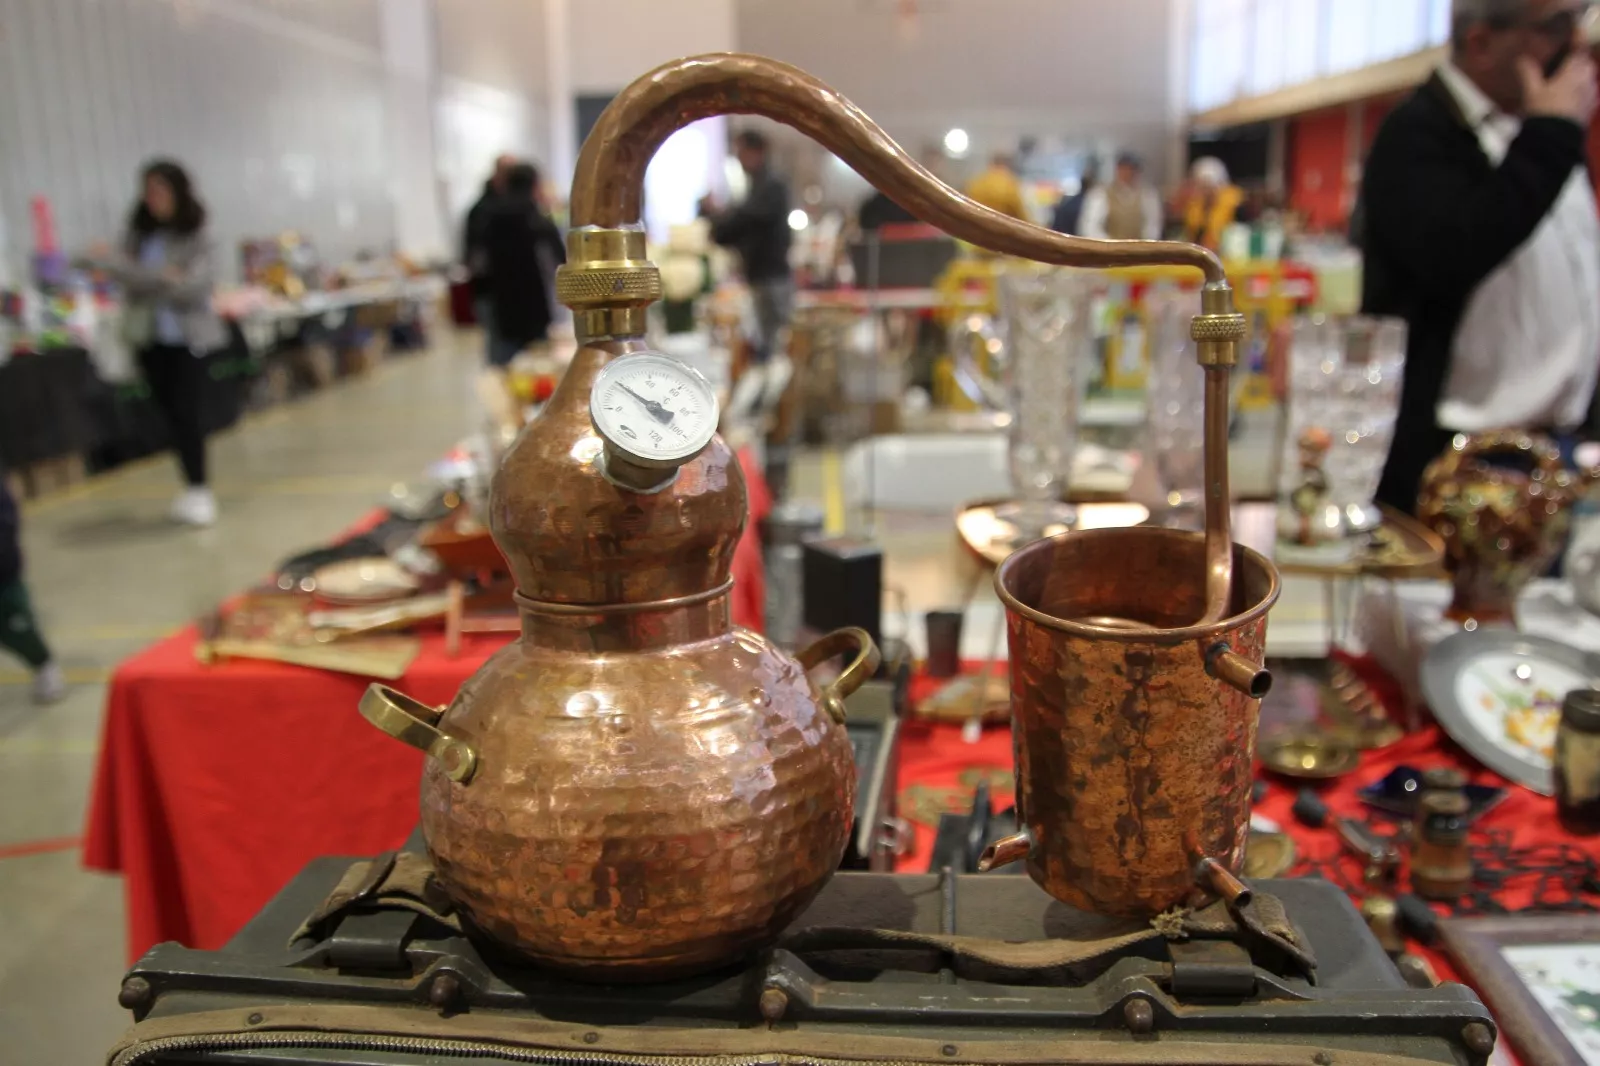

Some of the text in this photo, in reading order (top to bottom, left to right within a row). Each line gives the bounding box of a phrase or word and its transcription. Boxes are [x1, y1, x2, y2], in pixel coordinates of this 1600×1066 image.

[645, 380, 656, 389] 40
[669, 388, 680, 397] 60
[615, 405, 623, 413] 0
[680, 407, 690, 416] 80
[669, 422, 684, 435] 100
[648, 430, 663, 442] 120
